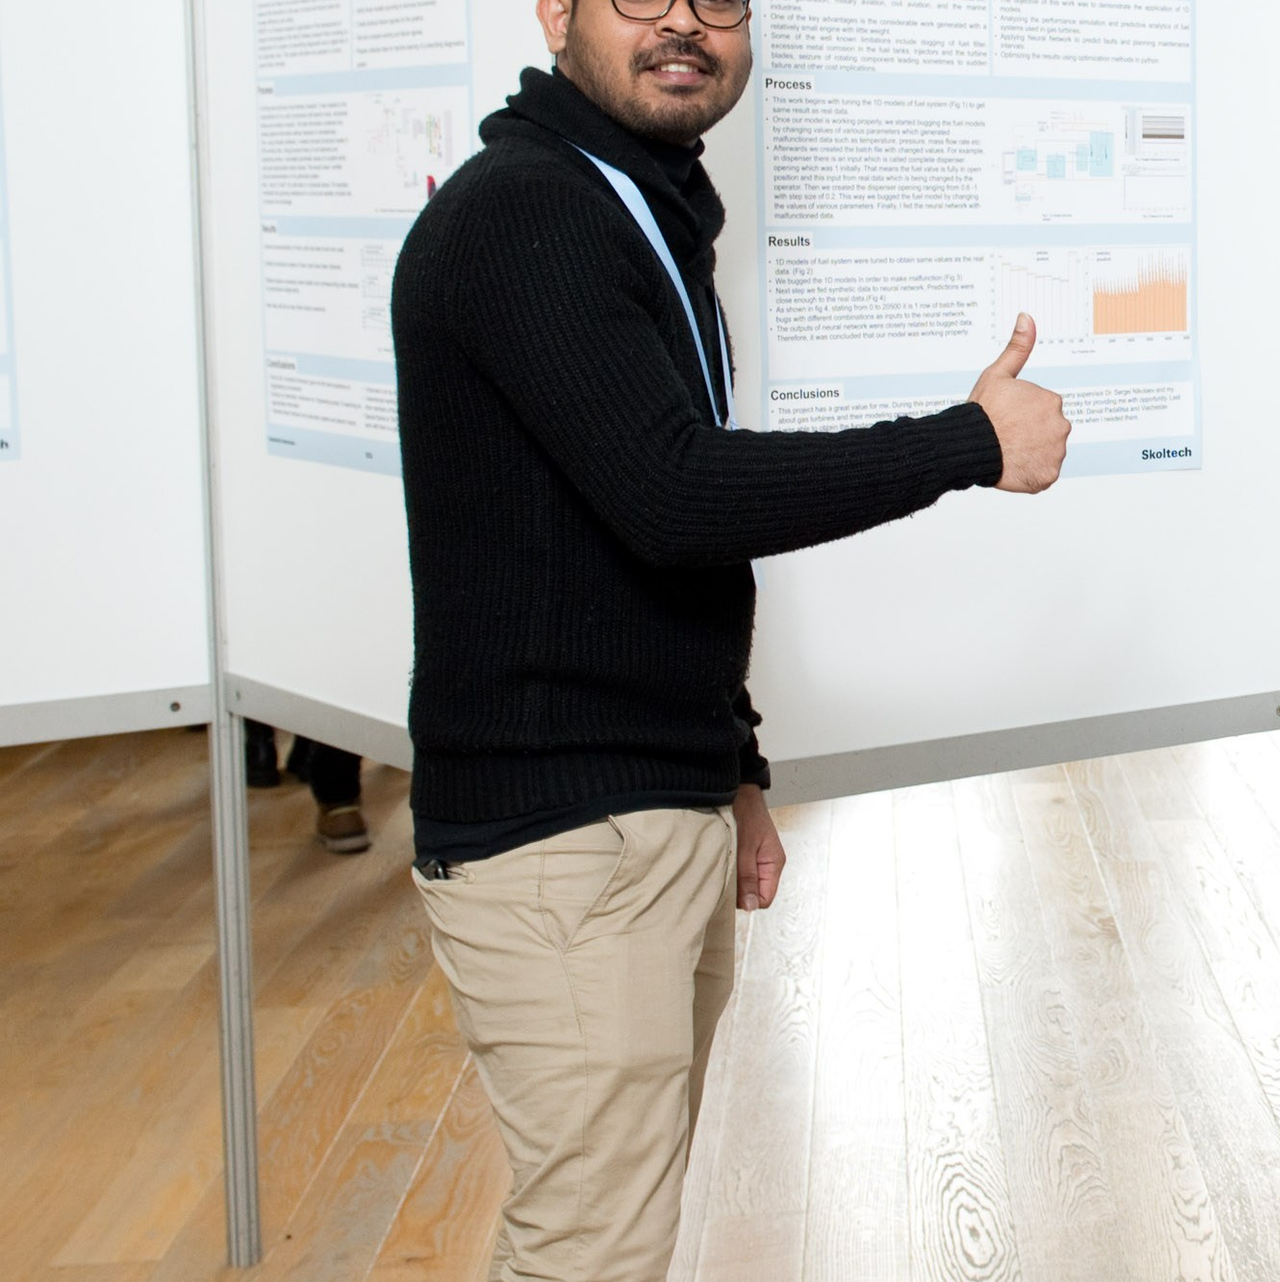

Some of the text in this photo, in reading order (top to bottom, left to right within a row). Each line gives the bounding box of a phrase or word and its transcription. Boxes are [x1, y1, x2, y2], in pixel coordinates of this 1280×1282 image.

[766, 78, 811, 89] Process
[768, 236, 810, 246] Results
[771, 389, 839, 401] Conclusions
[1142, 447, 1191, 460] Skoltech
